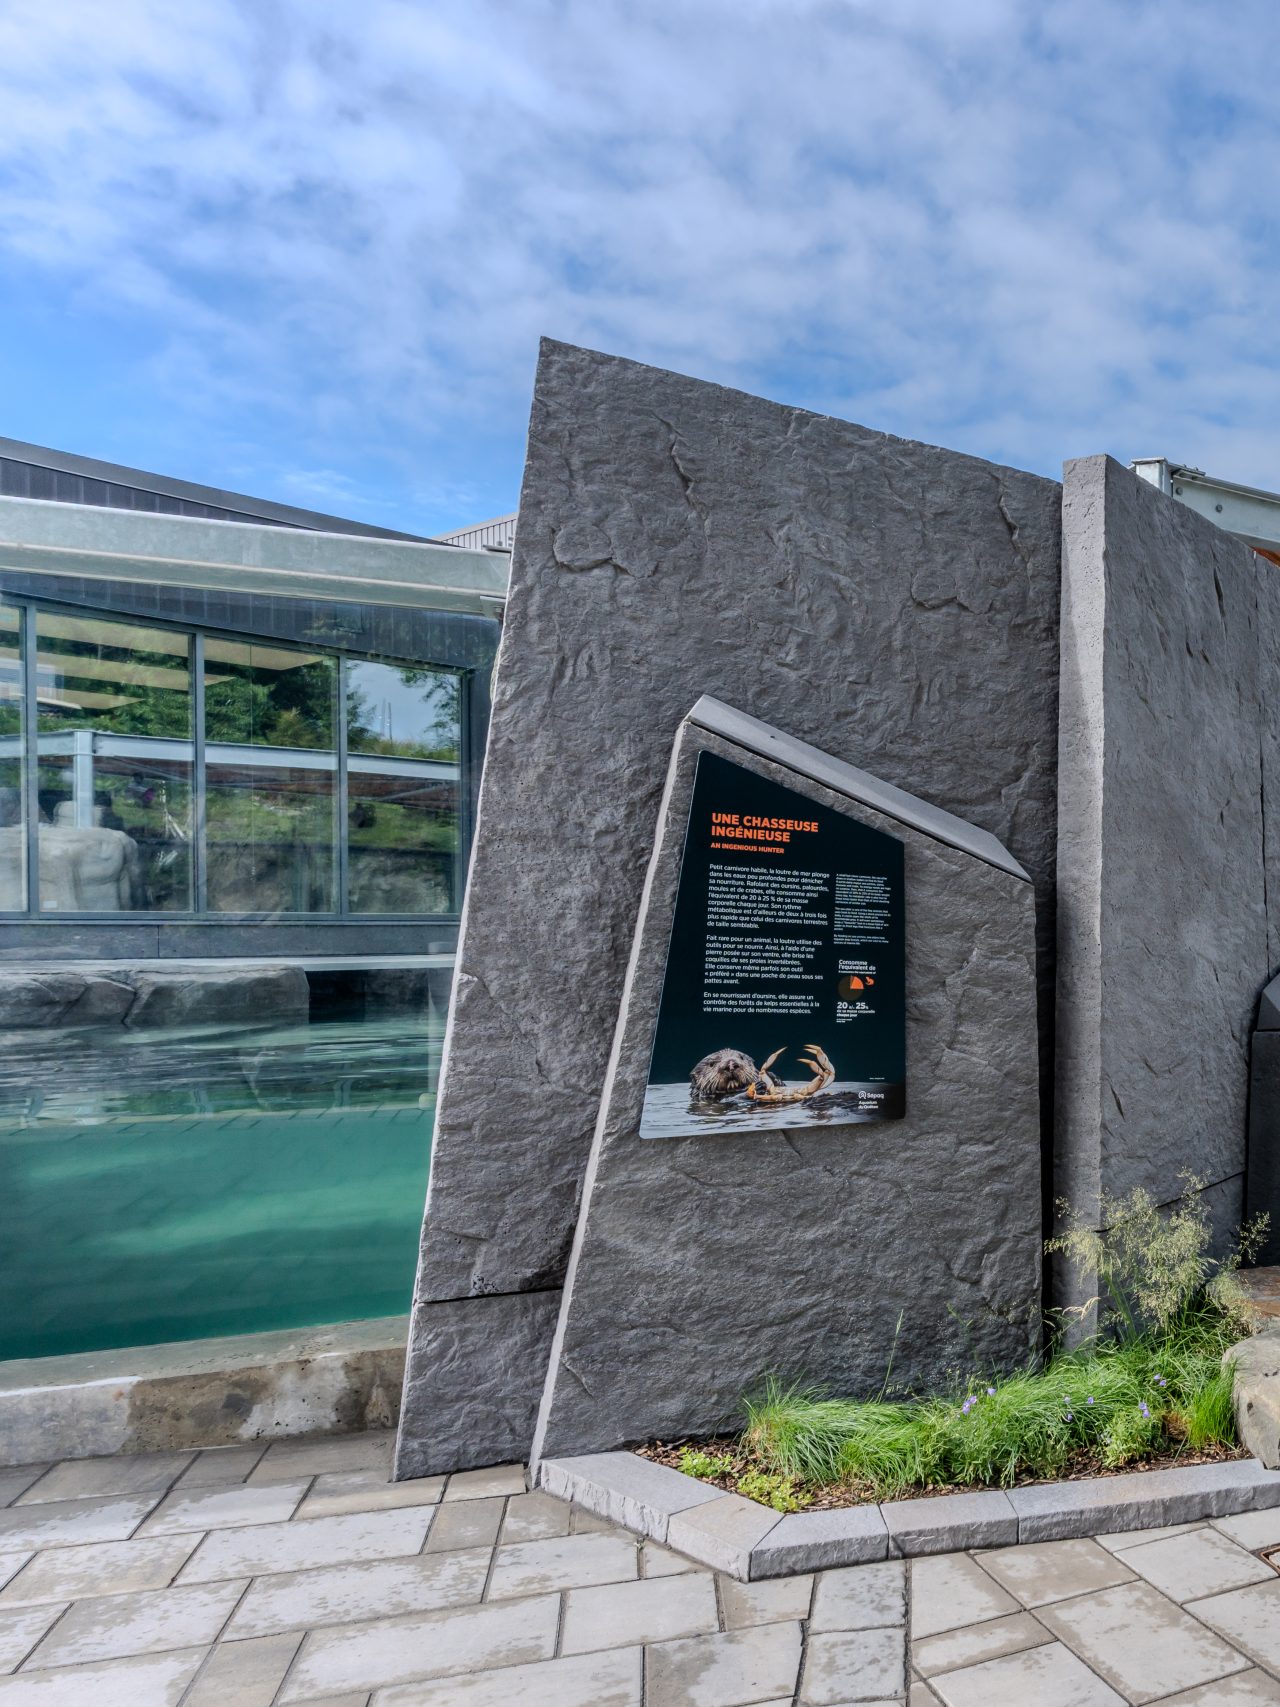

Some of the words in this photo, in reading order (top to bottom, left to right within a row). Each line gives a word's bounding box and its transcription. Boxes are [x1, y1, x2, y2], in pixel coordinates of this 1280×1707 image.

[712, 812, 740, 825] UNE
[743, 815, 819, 832] CHASSEUSE
[711, 825, 791, 842] INGÉNIEUSE
[722, 843, 758, 852] INGENIOUS
[758, 846, 785, 854] HUNTER
[751, 866, 768, 875] habile,
[811, 870, 829, 878] plonge
[759, 874, 786, 882] profondes
[717, 878, 745, 886] nourriture.
[781, 882, 801, 890] oursins,
[802, 883, 829, 892] palourdes,
[745, 887, 764, 895] crabes,
[708, 892, 740, 900] l'équivalent
[708, 899, 736, 907] corporelle
[737, 900, 757, 908] chaque
[757, 901, 769, 909] jour.
[782, 902, 801, 911] rythme
[708, 906, 742, 915] métabolique
[708, 913, 719, 921] plus
[720, 913, 738, 921] rapide
[775, 916, 802, 924] carnivores
[753, 936, 772, 944] animal,
[765, 944, 780, 952] Ainsi,
[705, 948, 722, 956] pierre
[723, 949, 740, 957] posée
[762, 950, 780, 958] ventre,
[705, 955, 730, 964] coquilles
[749, 957, 766, 965] proies
[761, 964, 779, 972] parfois
[709, 970, 730, 978] préféré
[761, 971, 778, 979] poche
[704, 977, 722, 985] pattes
[752, 992, 777, 1000] d'oursins,
[789, 1007, 811, 1015] espèces.
